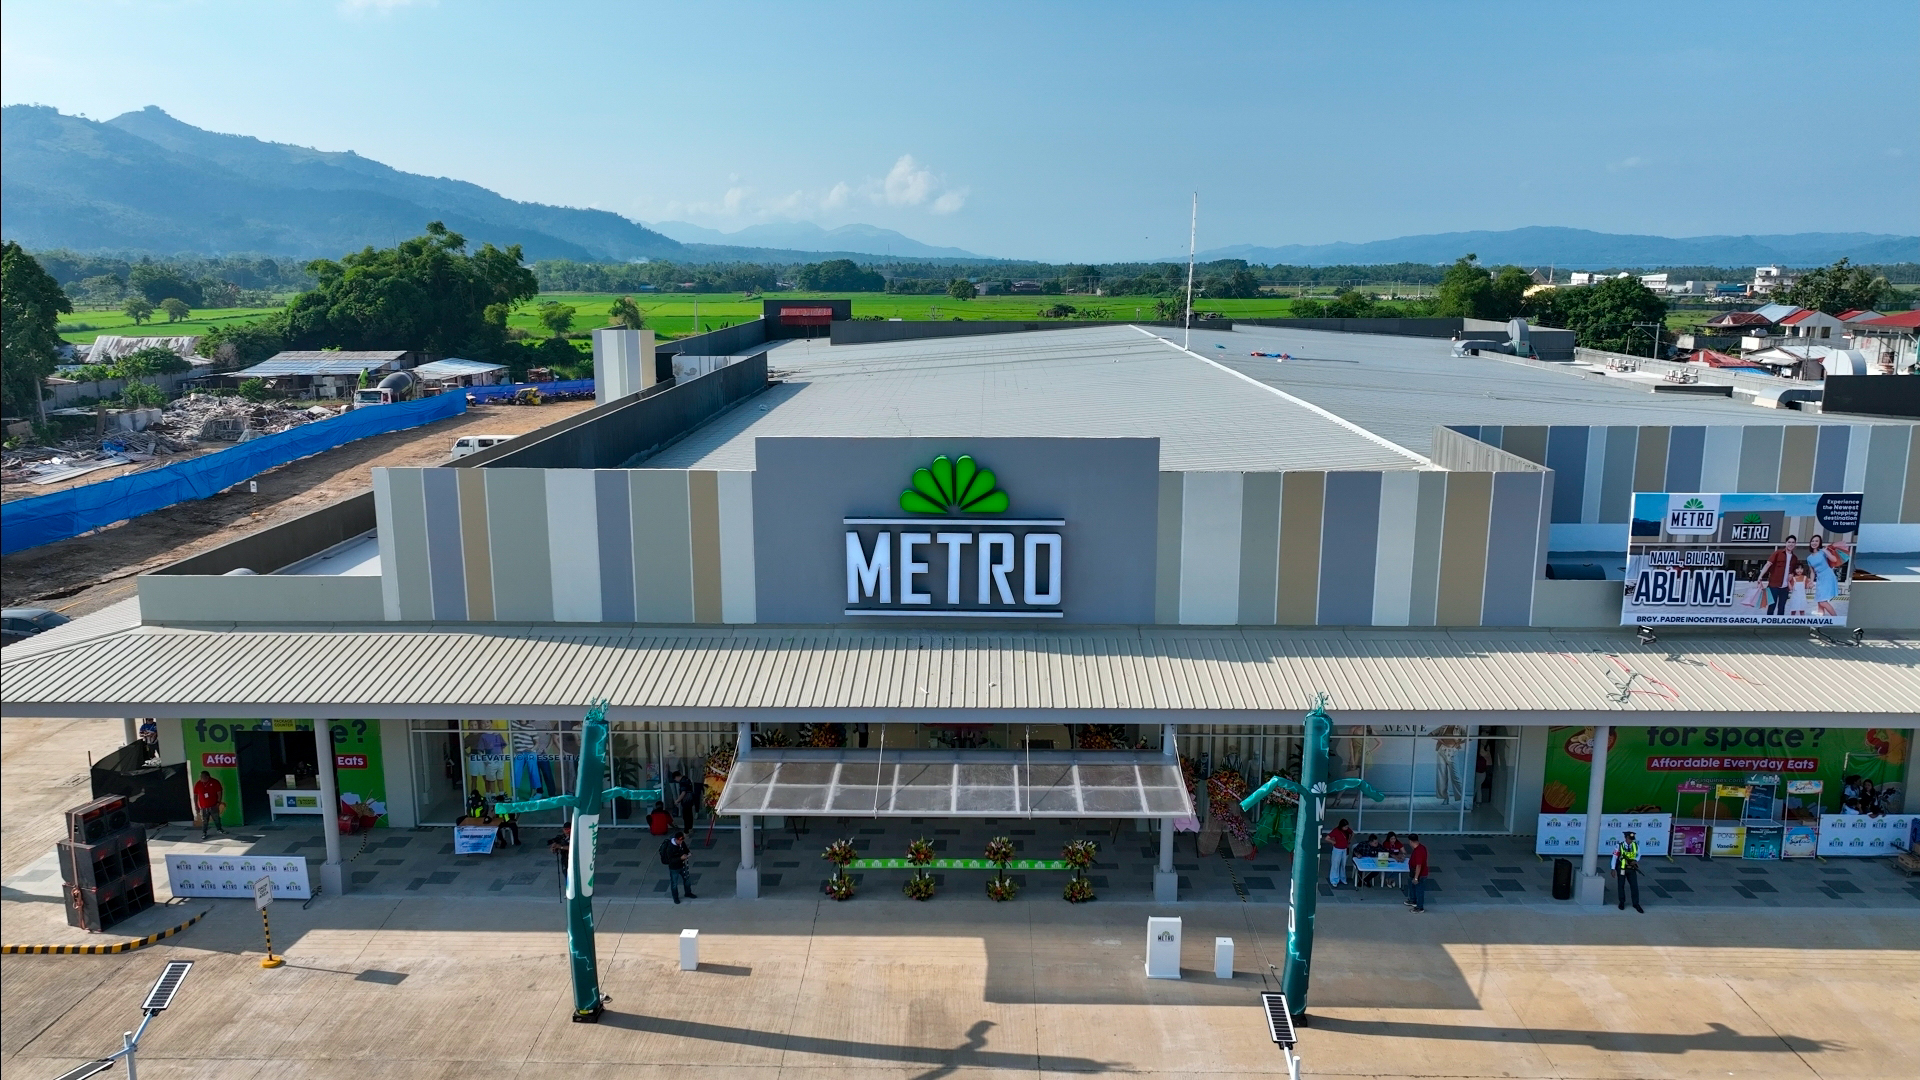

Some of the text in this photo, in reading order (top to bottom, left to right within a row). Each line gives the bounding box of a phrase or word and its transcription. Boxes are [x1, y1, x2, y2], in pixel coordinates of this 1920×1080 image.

[1671, 512, 1714, 527] METRO
[1731, 525, 1770, 540] METRO
[1649, 551, 1725, 567] NAVAL, BILIRAN
[845, 531, 1062, 605] METRO
[1633, 570, 1736, 605] ABLI NA!
[1636, 615, 1659, 623] BRGY.
[1659, 616, 1685, 624] PADRE
[1685, 616, 1728, 624] INOCENTES
[1728, 617, 1760, 625] GARCIA,
[1761, 617, 1806, 625] POBLACION
[1647, 727, 1698, 747] for
[206, 754, 364, 766] Affor Eats
[1651, 758, 1814, 771] Affordable Everyday Eats
